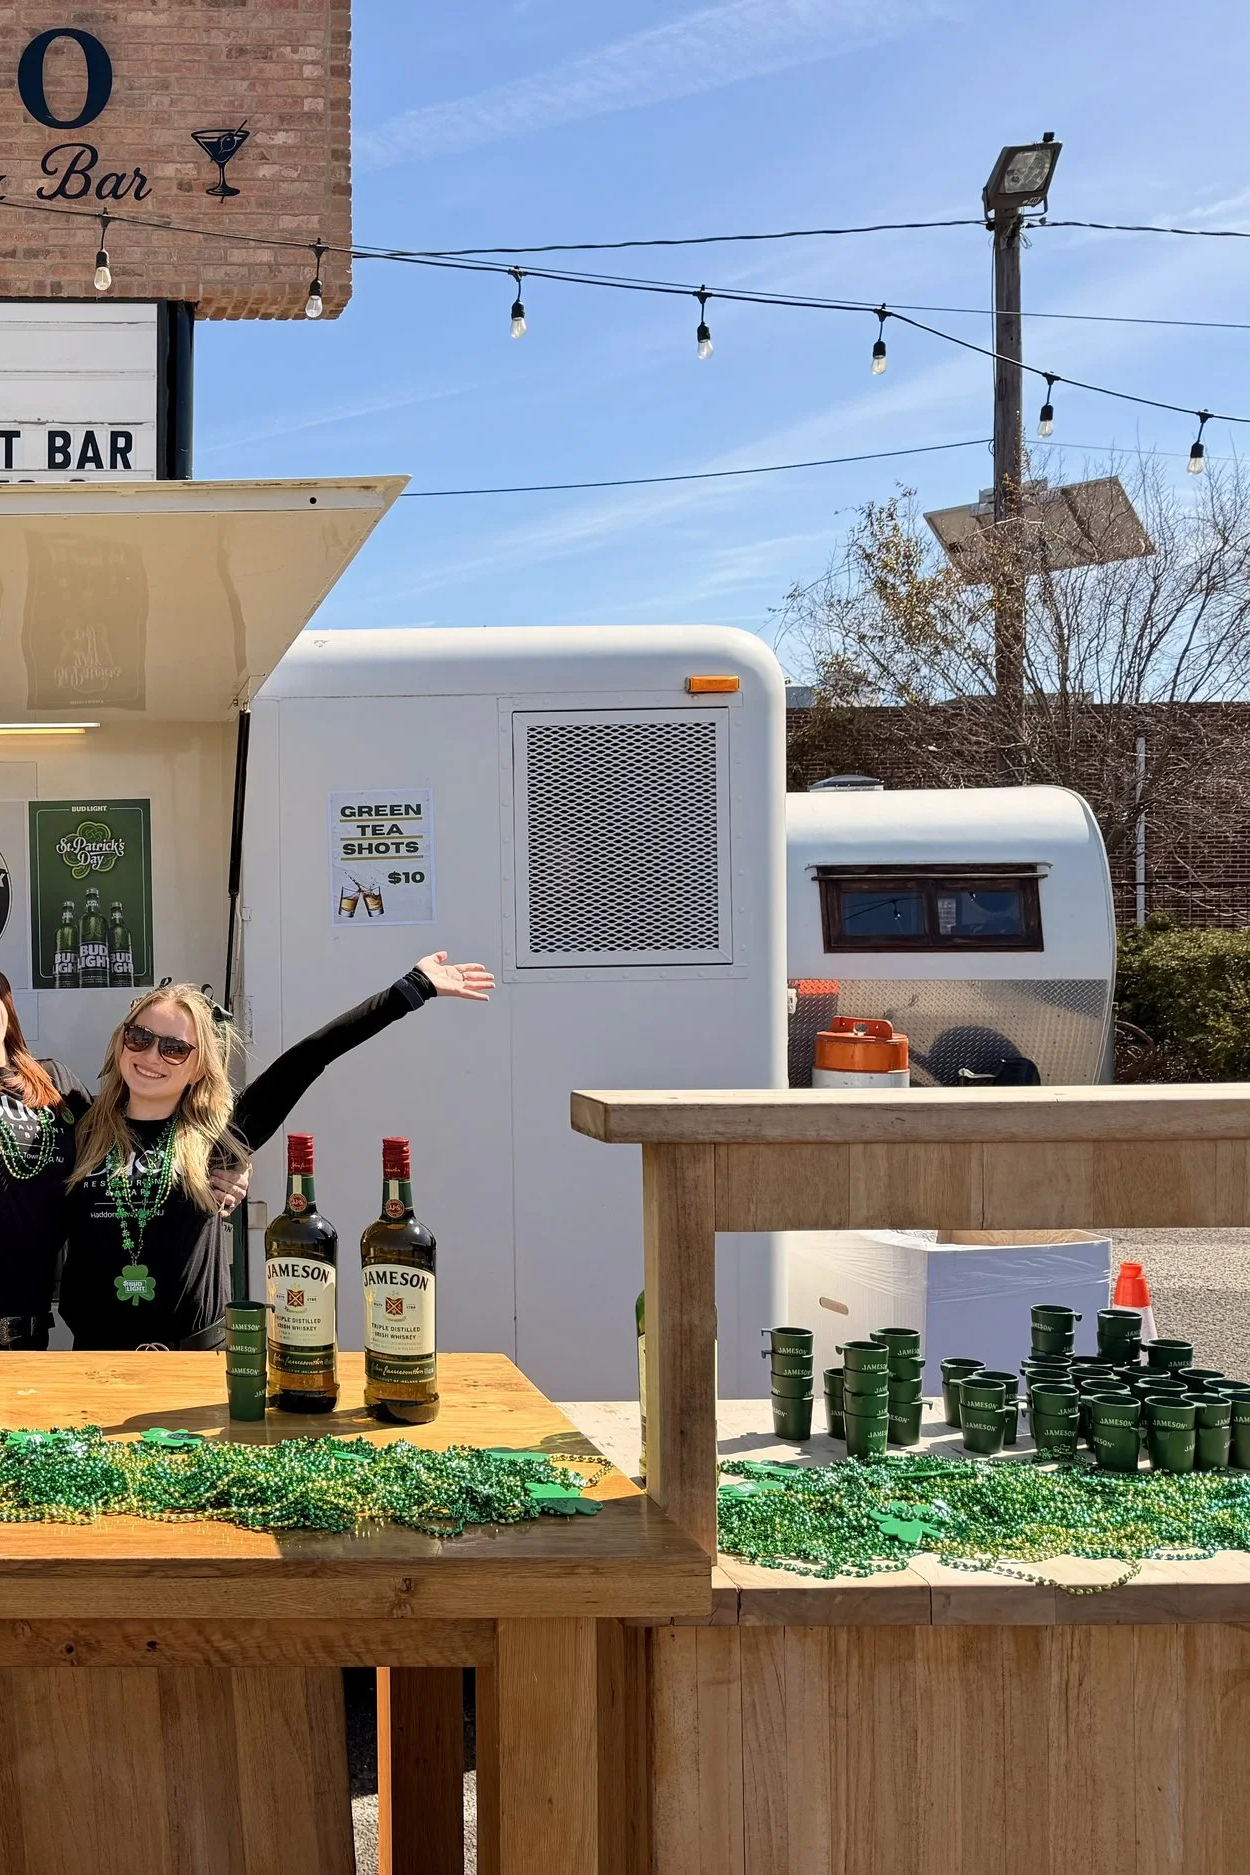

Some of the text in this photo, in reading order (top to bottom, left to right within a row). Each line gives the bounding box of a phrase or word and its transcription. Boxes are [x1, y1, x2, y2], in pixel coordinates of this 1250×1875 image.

[38, 143, 152, 201] Bar
[48, 430, 132, 470] BAR
[340, 804, 422, 818] GREEN
[356, 824, 404, 836] TEA
[72, 836, 125, 857] Patrick's
[342, 841, 419, 855] SHOTS
[77, 851, 104, 871] Day
[387, 871, 425, 885] $10
[79, 944, 108, 956] BUD
[267, 1263, 330, 1284] JAMESON
[363, 1270, 429, 1291] JAMESON
[291, 1316, 321, 1324] DISTILLED
[231, 1323, 259, 1331] JAMESON
[277, 1322, 317, 1332] IRISH WHISKEY
[371, 1322, 389, 1332] TRIPLE
[374, 1331, 389, 1339] IRISH
[229, 1344, 257, 1353] JAMESON
[777, 1347, 808, 1355] JAMESON
[230, 1367, 259, 1376] JAMESON
[966, 1400, 998, 1410] JAMESON
[965, 1422, 997, 1432] JAMESON
[1099, 1418, 1132, 1427] JAMESON
[1152, 1419, 1187, 1429] JAMESON
